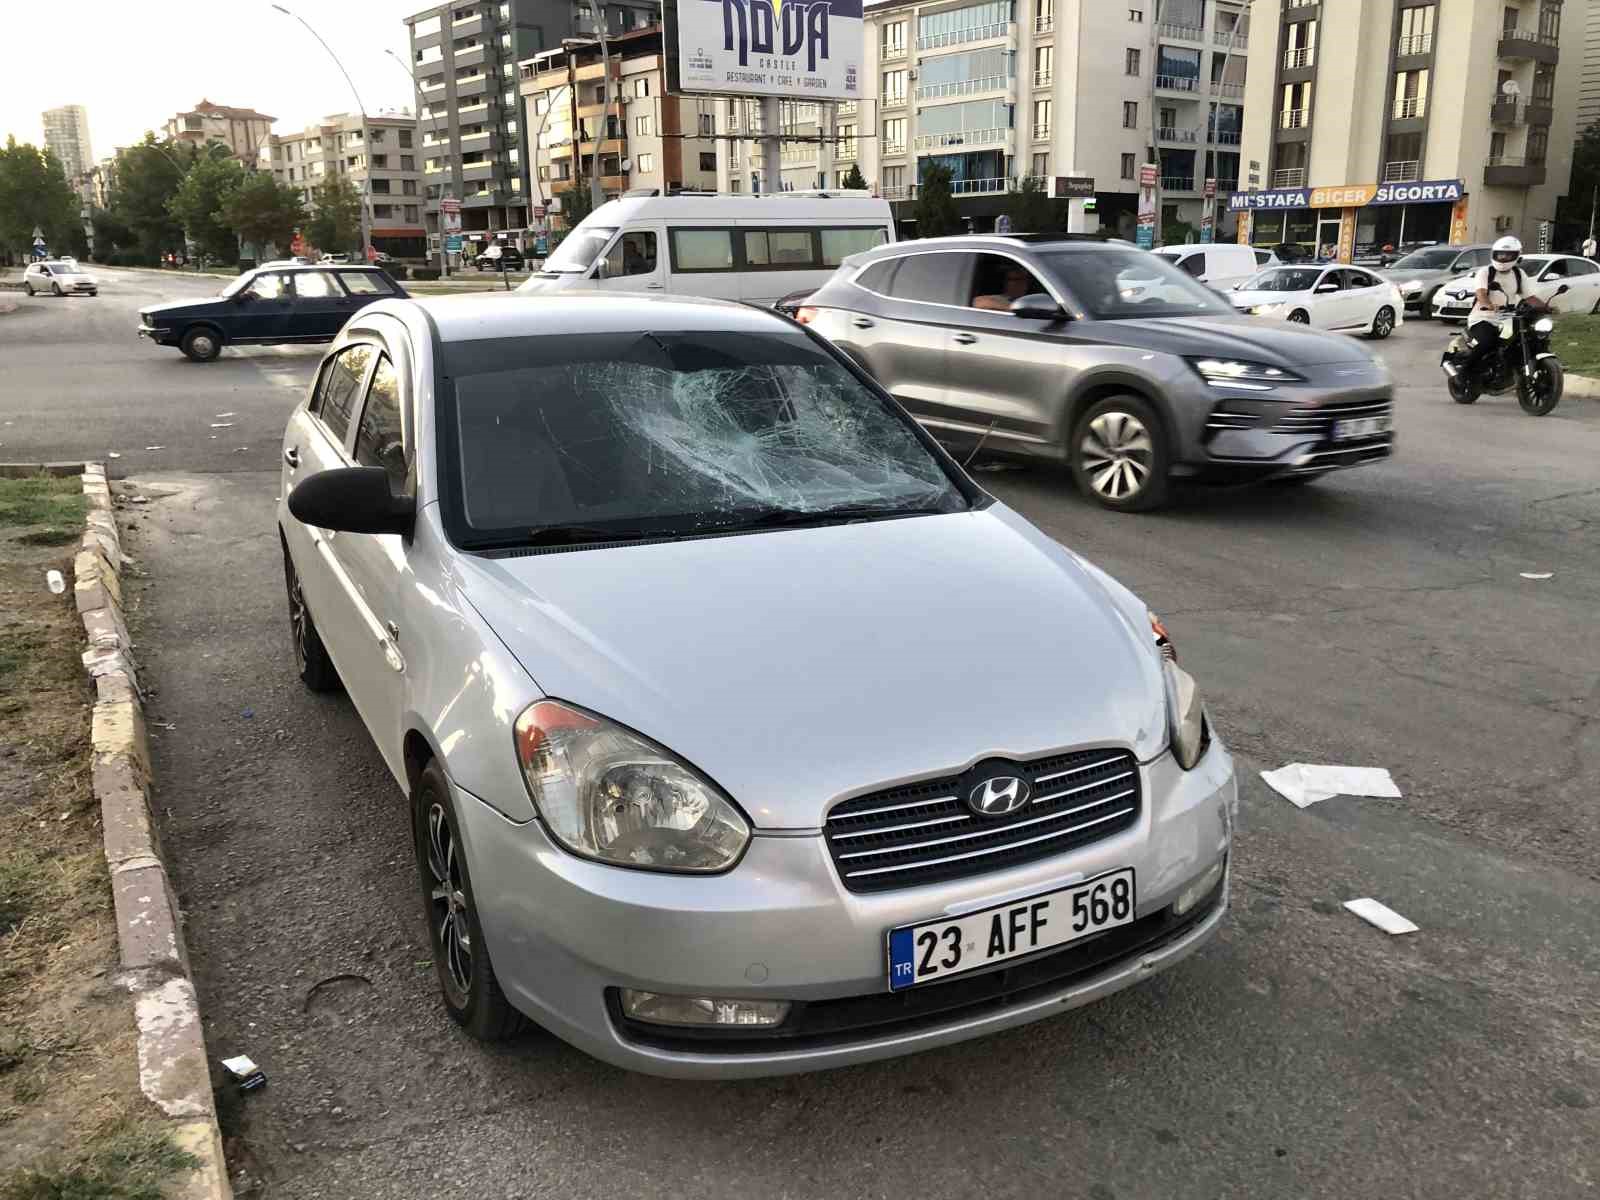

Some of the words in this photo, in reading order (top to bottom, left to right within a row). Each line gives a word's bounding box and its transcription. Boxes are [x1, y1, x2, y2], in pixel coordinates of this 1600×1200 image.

[722, 0, 832, 71] NOVA
[760, 58, 796, 71] CASTLE
[726, 72, 766, 84] RESTAURANT
[1376, 185, 1458, 201] SİGORTA
[917, 926, 962, 977] 23
[987, 901, 1050, 959] AFF
[1072, 878, 1130, 932] 568
[895, 961, 912, 977] TR
